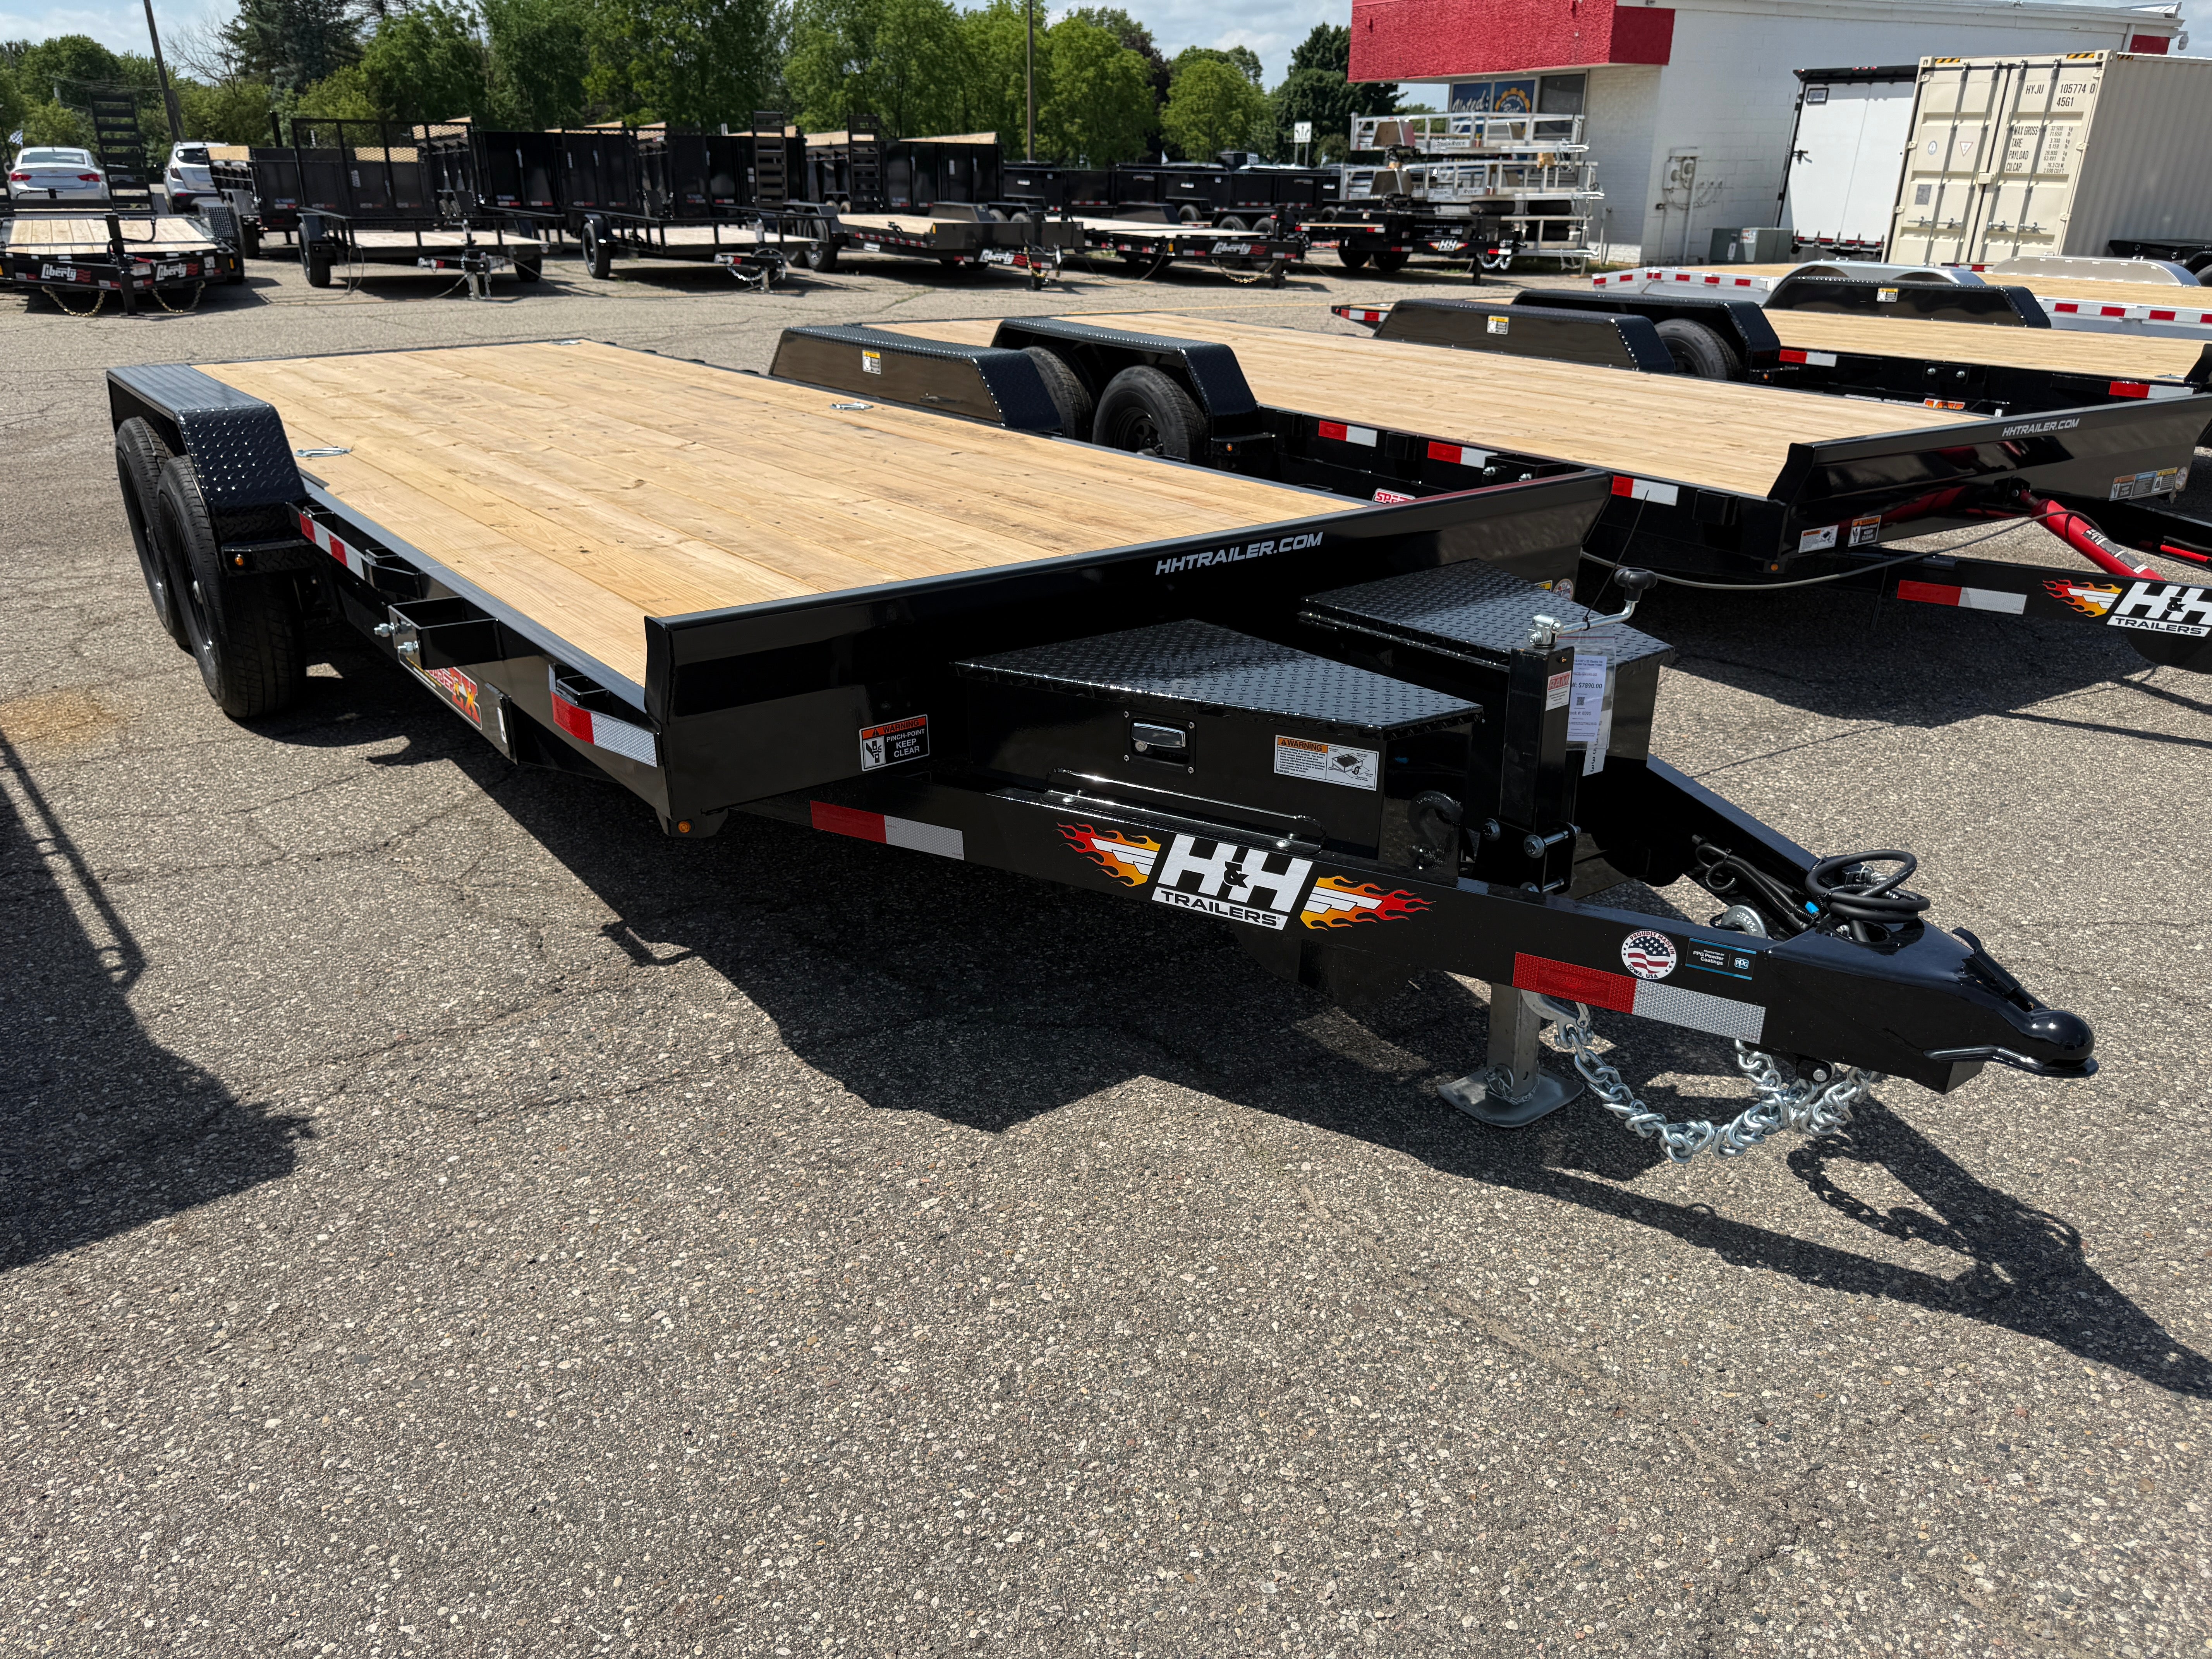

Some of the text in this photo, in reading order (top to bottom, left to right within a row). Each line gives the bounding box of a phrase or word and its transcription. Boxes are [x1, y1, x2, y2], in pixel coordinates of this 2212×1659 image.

[2026, 83, 2095, 94] HYJU 105774 0
[2057, 97, 2074, 106] 45G1
[2014, 126, 2024, 135] MAX
[2024, 126, 2039, 135] GROSS
[2012, 138, 2023, 148] TARE
[2008, 150, 2029, 160] PAYLOAD
[1211, 241, 1252, 255] Liberty
[978, 249, 1015, 264] Liberty
[41, 263, 77, 281] Liberty
[155, 263, 187, 281] Liberty
[2002, 418, 2080, 437] HHTRAILER.COM
[1156, 532, 1323, 575] HHTRAILER.COM
[2116, 618, 2204, 635] TRAILERS
[1549, 675, 1569, 689] RAM
[883, 720, 919, 733] WARNING
[886, 728, 925, 742] PINCH-POINT
[896, 738, 917, 749] KEEP
[1287, 740, 1322, 751] WARNING
[894, 746, 920, 757] CLEAR
[1158, 834, 1313, 913] H&H
[1161, 890, 1277, 927] TRAILERS
[1630, 931, 1657, 940] PROUDLY
[1657, 934, 1672, 948] MADE
[1700, 957, 1723, 965] Coatings
[1627, 964, 1644, 978] IOWA,
